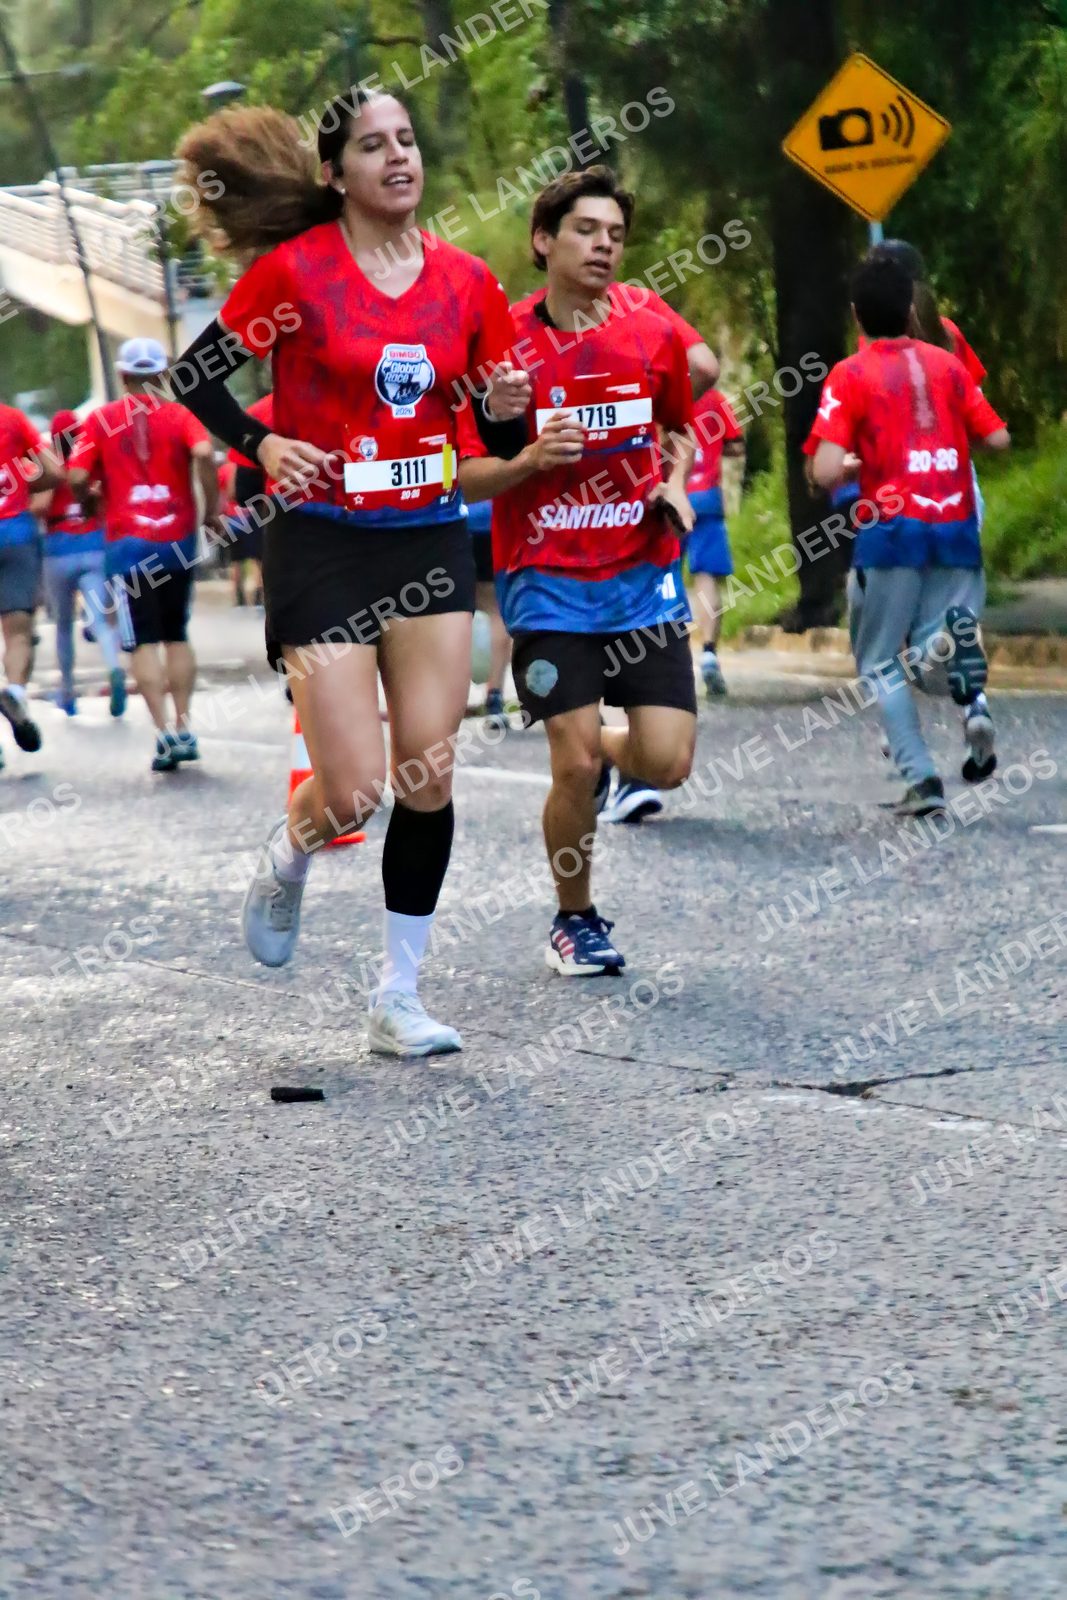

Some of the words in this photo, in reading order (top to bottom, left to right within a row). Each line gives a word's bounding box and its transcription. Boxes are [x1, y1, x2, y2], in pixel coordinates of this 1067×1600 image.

[384, 373, 409, 383] Race
[391, 361, 421, 374] Global
[577, 405, 617, 429] 1719
[391, 458, 427, 487] 3111
[539, 500, 644, 529] SANTIAGO
